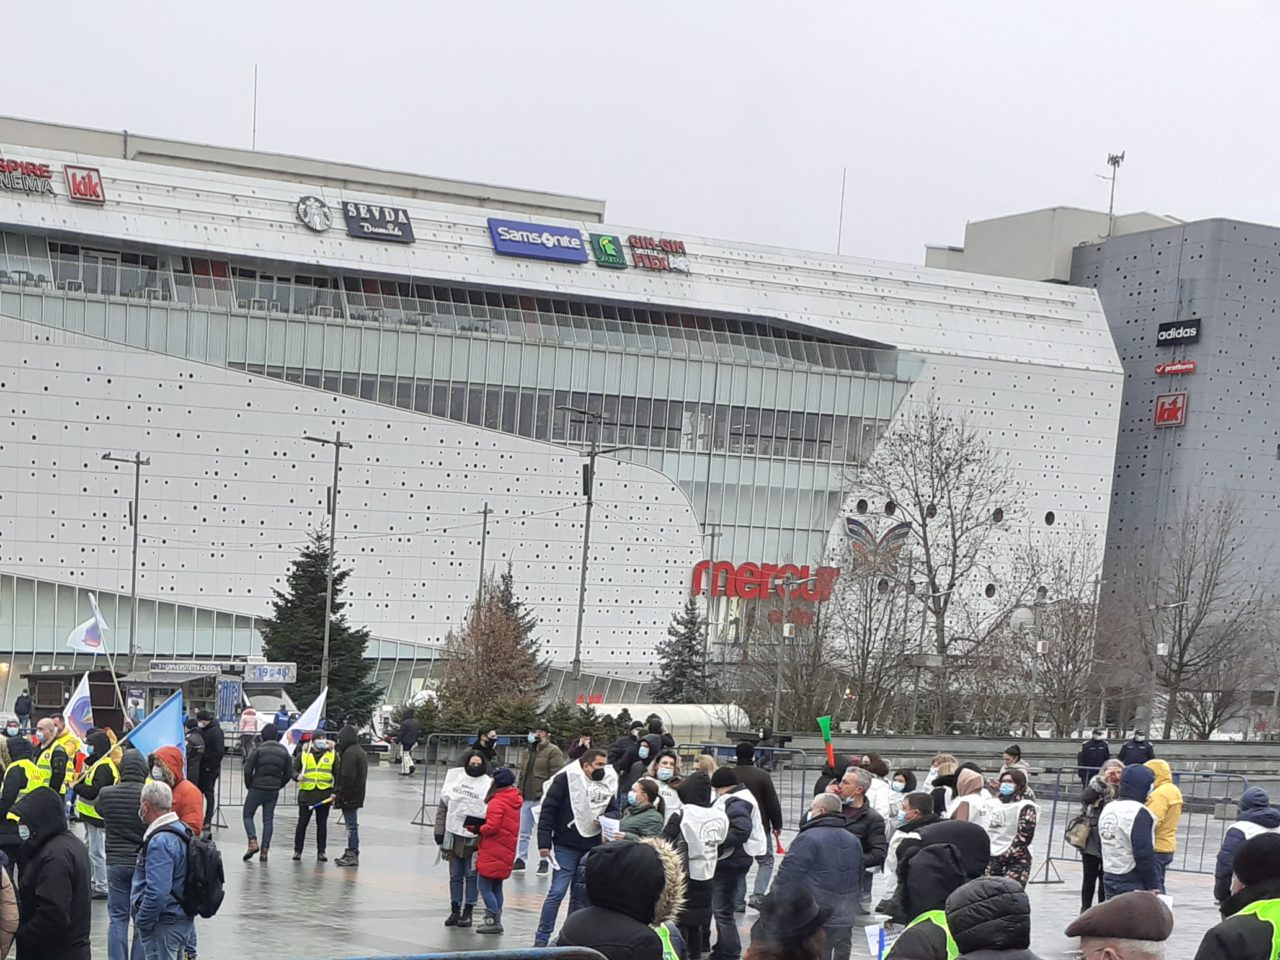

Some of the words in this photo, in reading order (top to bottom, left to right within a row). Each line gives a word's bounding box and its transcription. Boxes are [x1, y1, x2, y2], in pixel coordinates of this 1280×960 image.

[347, 203, 408, 223] SEVDA
[497, 226, 581, 249] Samsonite
[633, 253, 670, 270] FLEX
[1158, 327, 1197, 340] adidas
[691, 560, 840, 602] mercur
